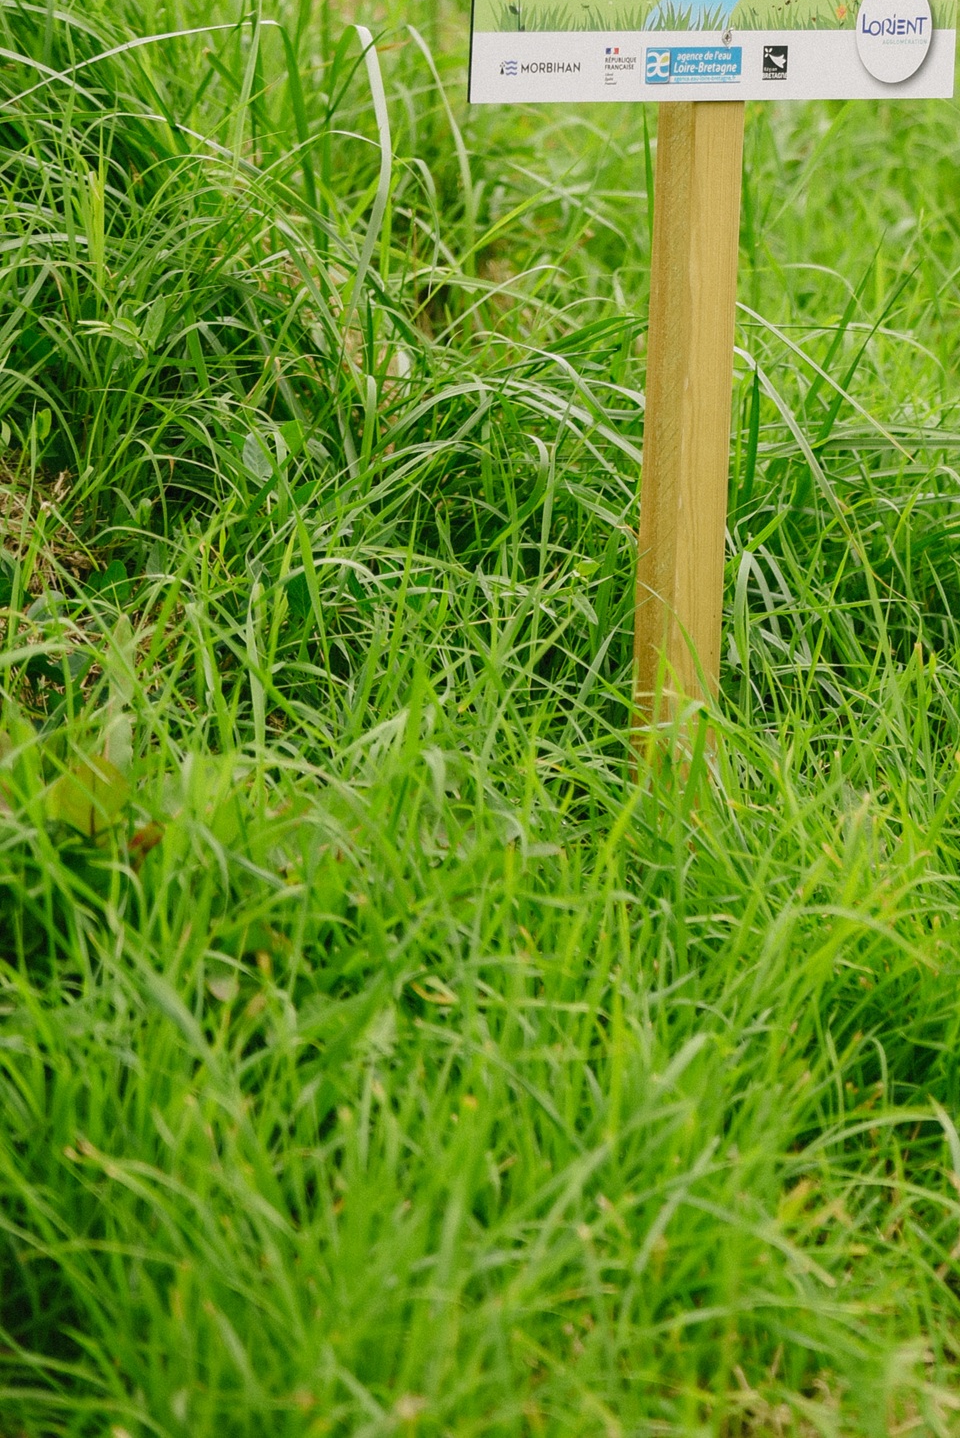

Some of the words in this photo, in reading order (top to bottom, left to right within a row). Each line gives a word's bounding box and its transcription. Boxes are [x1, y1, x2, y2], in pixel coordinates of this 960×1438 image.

[862, 13, 928, 36] LORIENT
[604, 56, 637, 64] RÉPUBLIQUE
[676, 52, 703, 63] agence
[703, 51, 714, 61] de
[714, 50, 732, 61] l'eau
[520, 62, 580, 73] MORBIHAN
[673, 62, 738, 75] Loire-Bretagne
